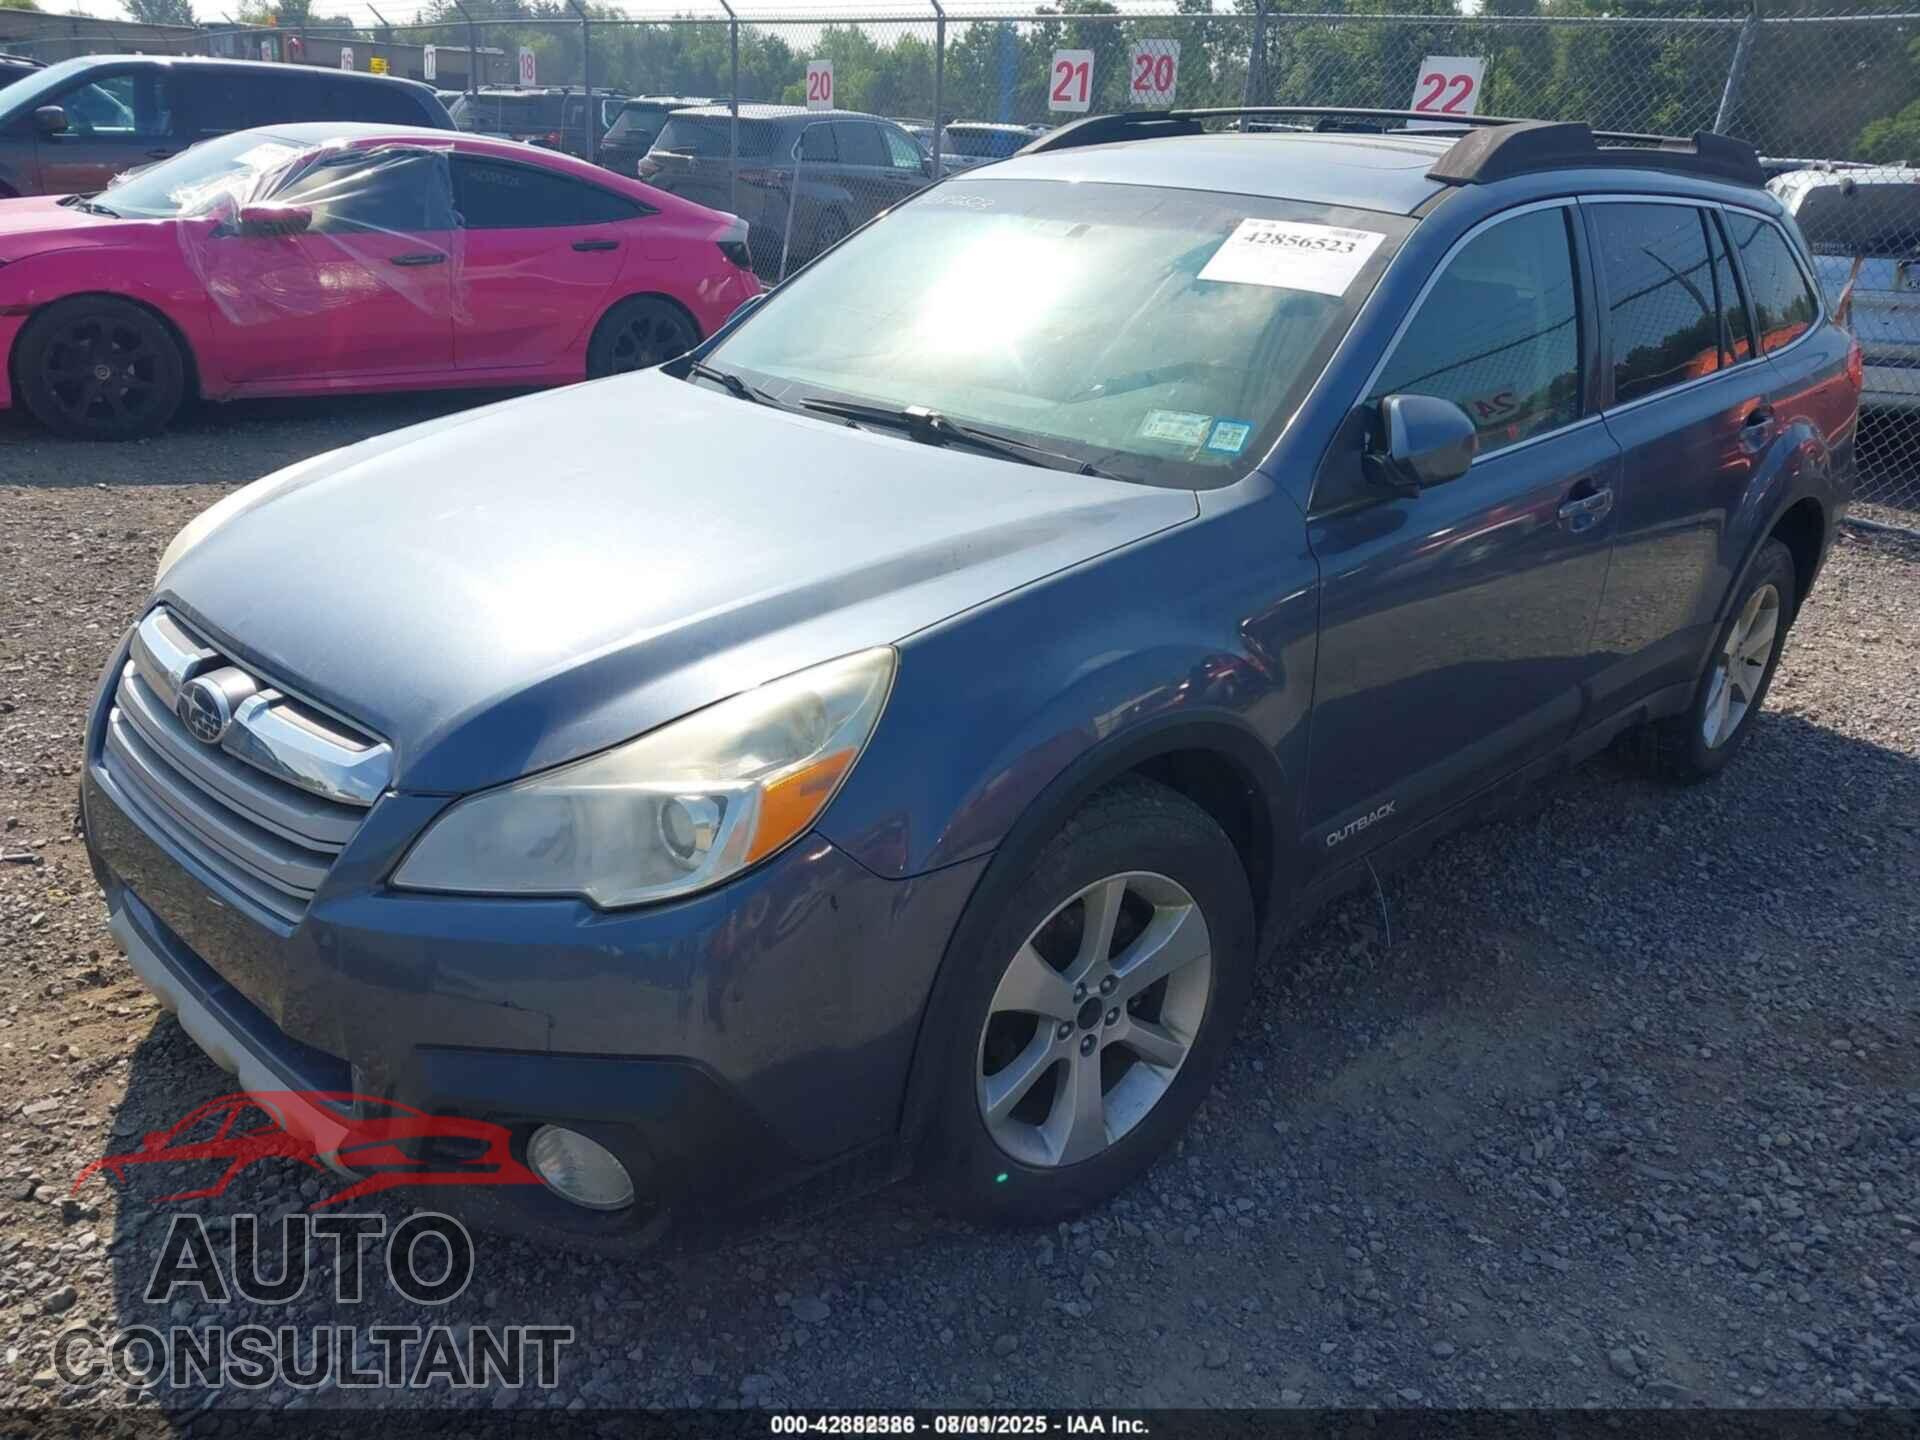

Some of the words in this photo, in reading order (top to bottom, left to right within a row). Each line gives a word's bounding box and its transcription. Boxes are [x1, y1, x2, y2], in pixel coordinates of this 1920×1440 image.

[424, 50, 436, 76] 17
[520, 53, 535, 80] 18
[1134, 53, 1174, 92] 20
[808, 70, 832, 101] 20
[1052, 60, 1090, 103] 21
[1415, 72, 1474, 115] 22
[1242, 231, 1357, 254] 42856523
[1325, 800, 1397, 847] OUTBACK
